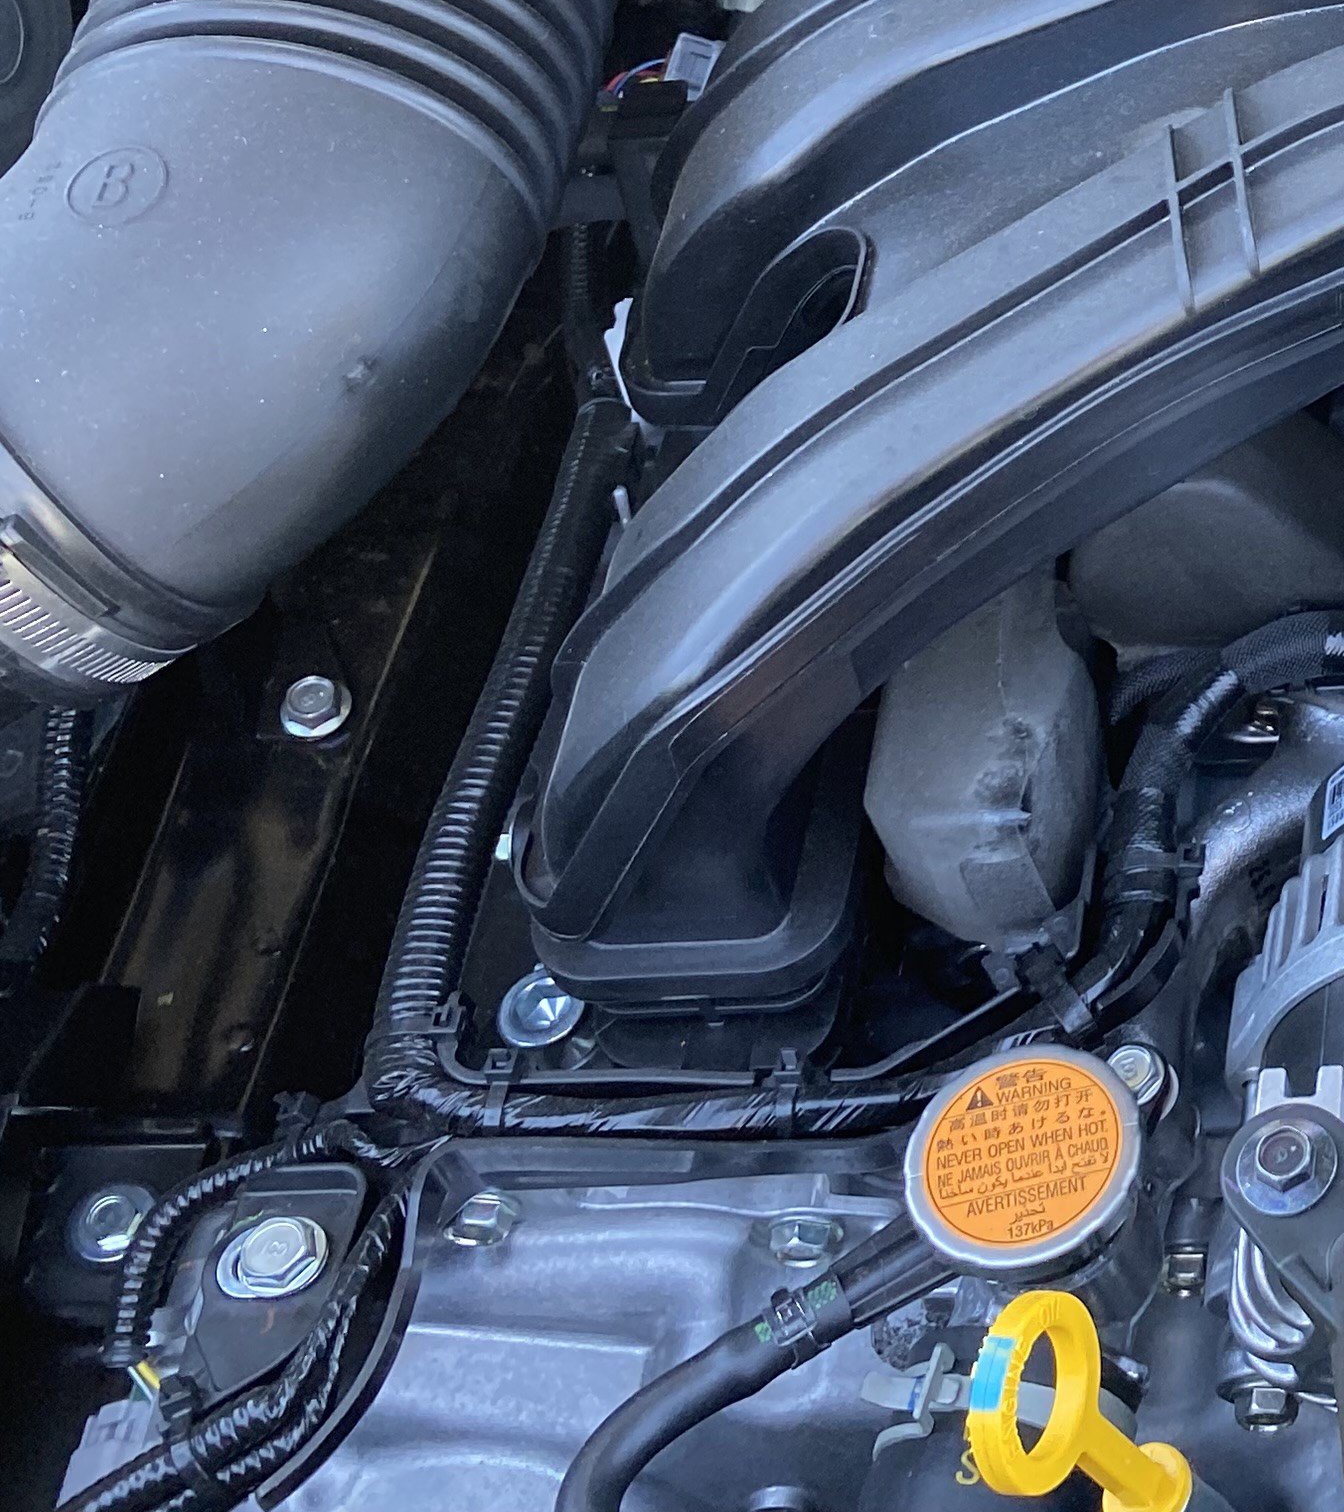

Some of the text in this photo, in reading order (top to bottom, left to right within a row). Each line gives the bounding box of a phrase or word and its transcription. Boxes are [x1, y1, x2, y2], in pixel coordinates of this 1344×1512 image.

[995, 1068, 1046, 1090] 警告
[995, 1078, 1072, 1104] WARNING
[949, 1090, 1093, 1131] 高温时请勿打开
[936, 1147, 988, 1170] NEVER
[988, 1140, 1025, 1159] OPEN
[1030, 1129, 1073, 1148] WHEN
[937, 1174, 955, 1188] NE
[957, 1163, 1001, 1183] JAMAIS
[1006, 1152, 1051, 1172] OUVRIR
[1055, 1144, 1064, 1160] À
[966, 1176, 1088, 1218] AVERTISSEMENT
[1006, 1220, 1054, 1239] 137kPa
